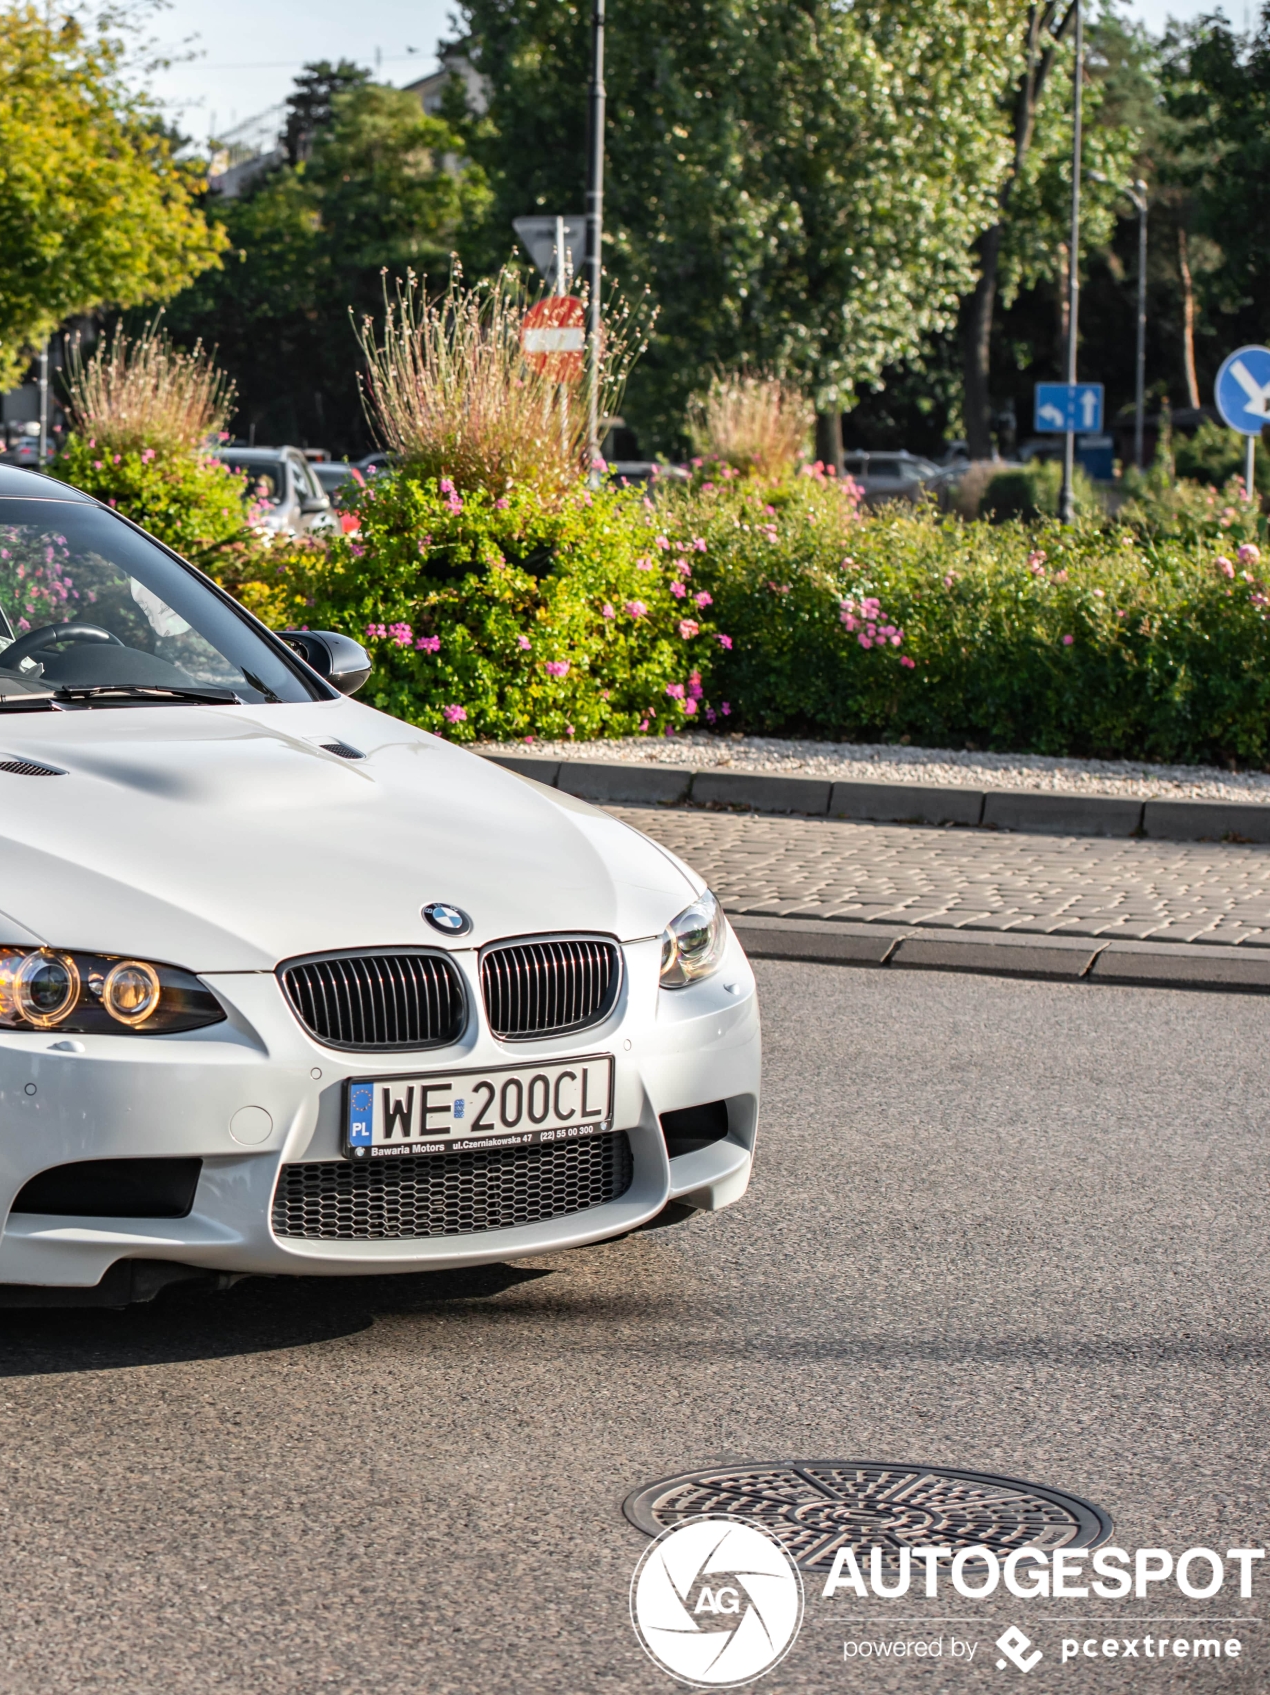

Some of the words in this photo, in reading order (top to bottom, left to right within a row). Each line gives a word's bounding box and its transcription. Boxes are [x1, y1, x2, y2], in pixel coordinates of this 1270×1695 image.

[382, 1083, 453, 1139] WE
[470, 1066, 602, 1132] 200CL
[352, 1122, 370, 1137] PL
[371, 1145, 410, 1156] Bawaria
[412, 1143, 445, 1154] Motors
[452, 1134, 522, 1150] ul.Czerniakowska
[522, 1134, 533, 1143] 47
[540, 1130, 555, 1141] (22)
[556, 1128, 566, 1138] 55
[567, 1127, 577, 1136] 00
[579, 1125, 594, 1135] 300
